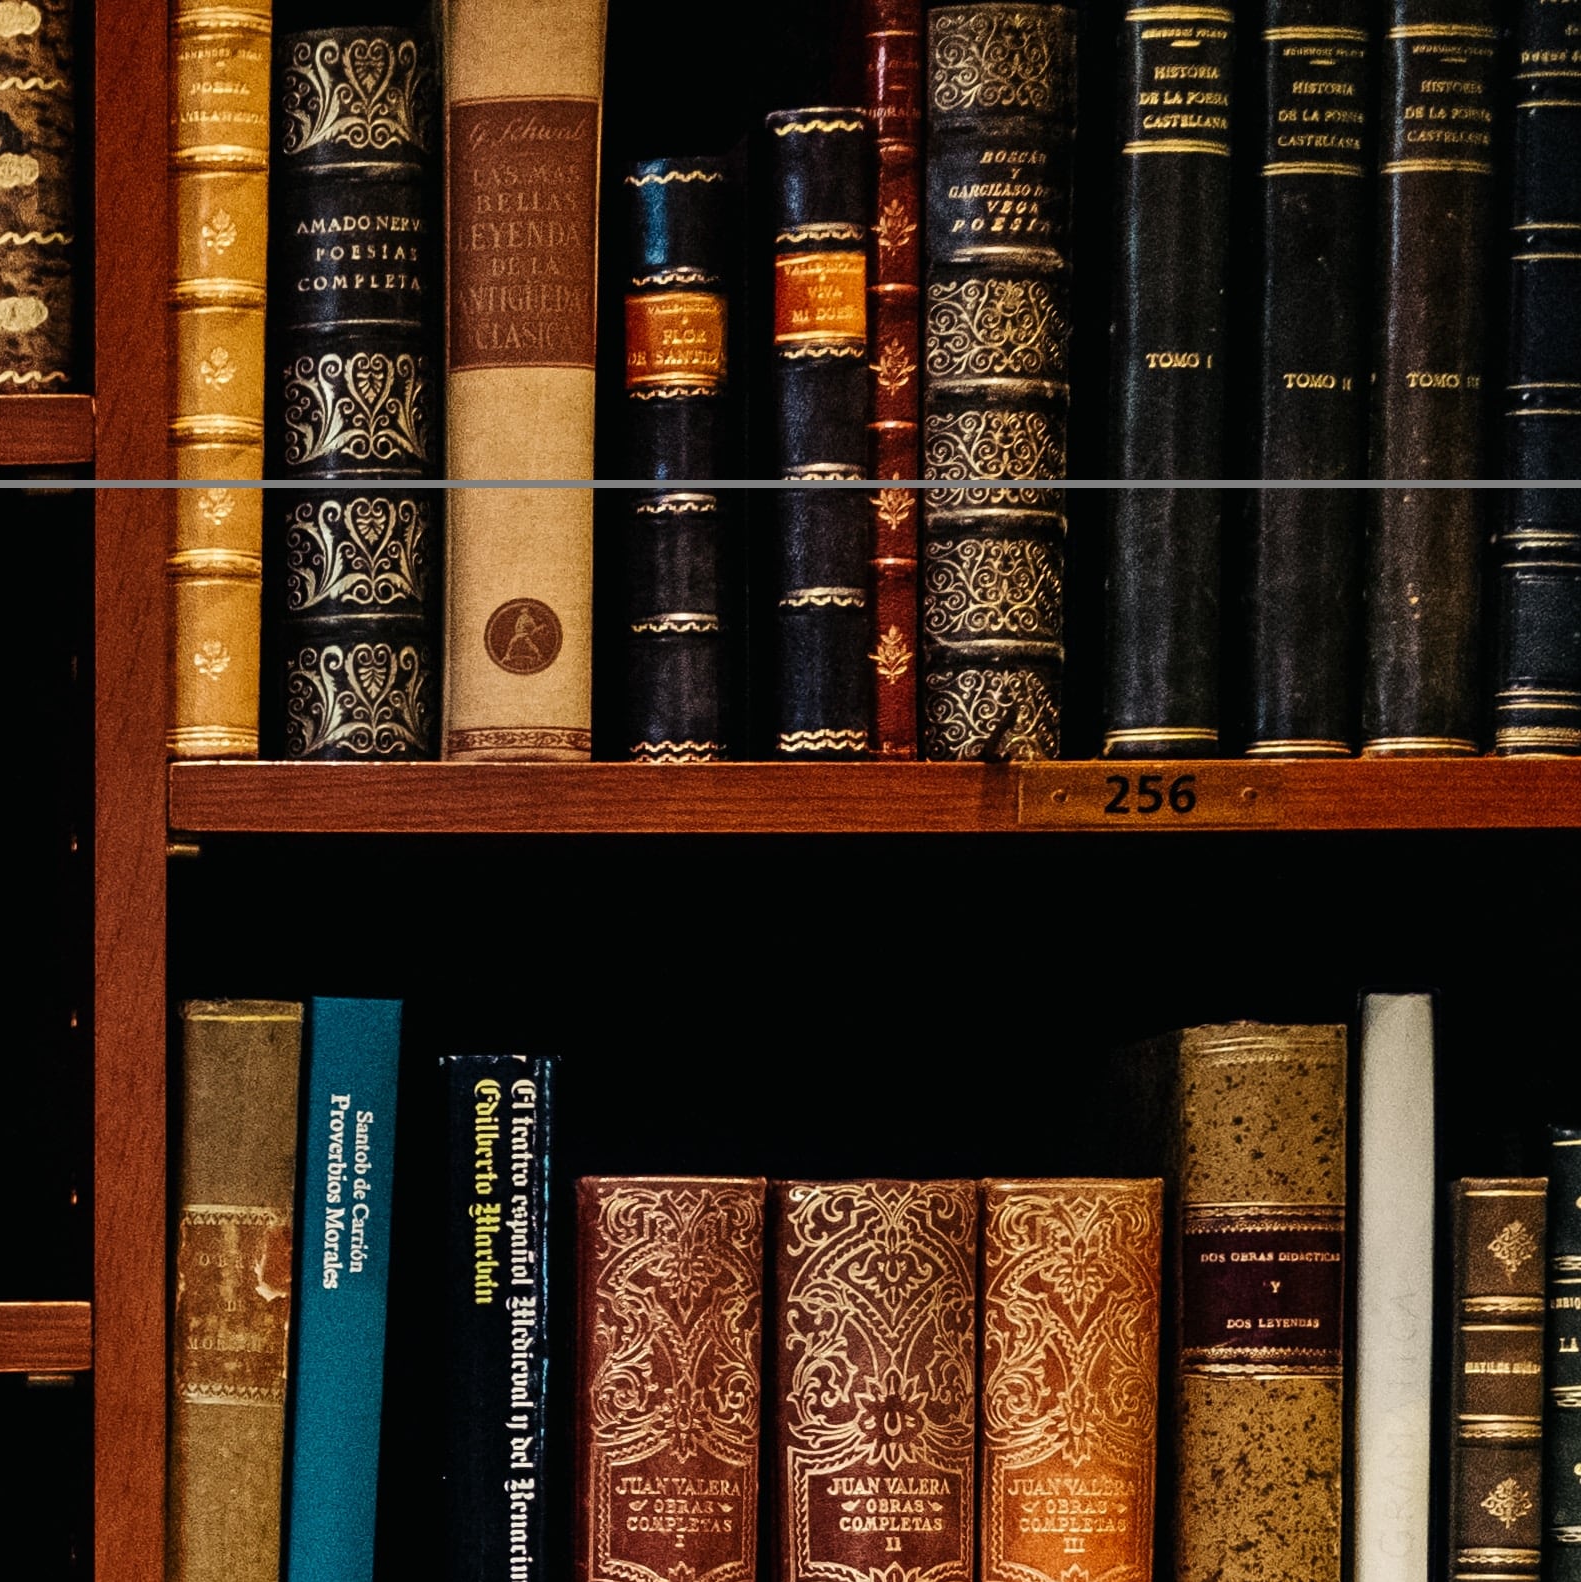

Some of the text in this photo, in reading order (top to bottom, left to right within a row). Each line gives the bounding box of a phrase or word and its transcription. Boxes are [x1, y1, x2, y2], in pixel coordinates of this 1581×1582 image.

[1155, 66, 1219, 81] HISTORIA
[1144, 114, 1228, 130] CASTELLANA
[297, 215, 425, 234] AMADO NERV
[1147, 352, 1213, 370] TOMO I
[1284, 372, 1335, 391] TOMO
[1104, 774, 1196, 814] 256
[322, 1093, 351, 1289] Proverbios Morales
[349, 1110, 374, 1273] Santob de Carrión
[505, 1194, 535, 1286] español
[1227, 1317, 1320, 1329] DOS LEYENDAS
[509, 1437, 534, 1469] del
[827, 1477, 950, 1496] JUAN VALERA
[866, 1499, 924, 1513] OBRAS
[840, 1517, 943, 1532] COMPLETAS
